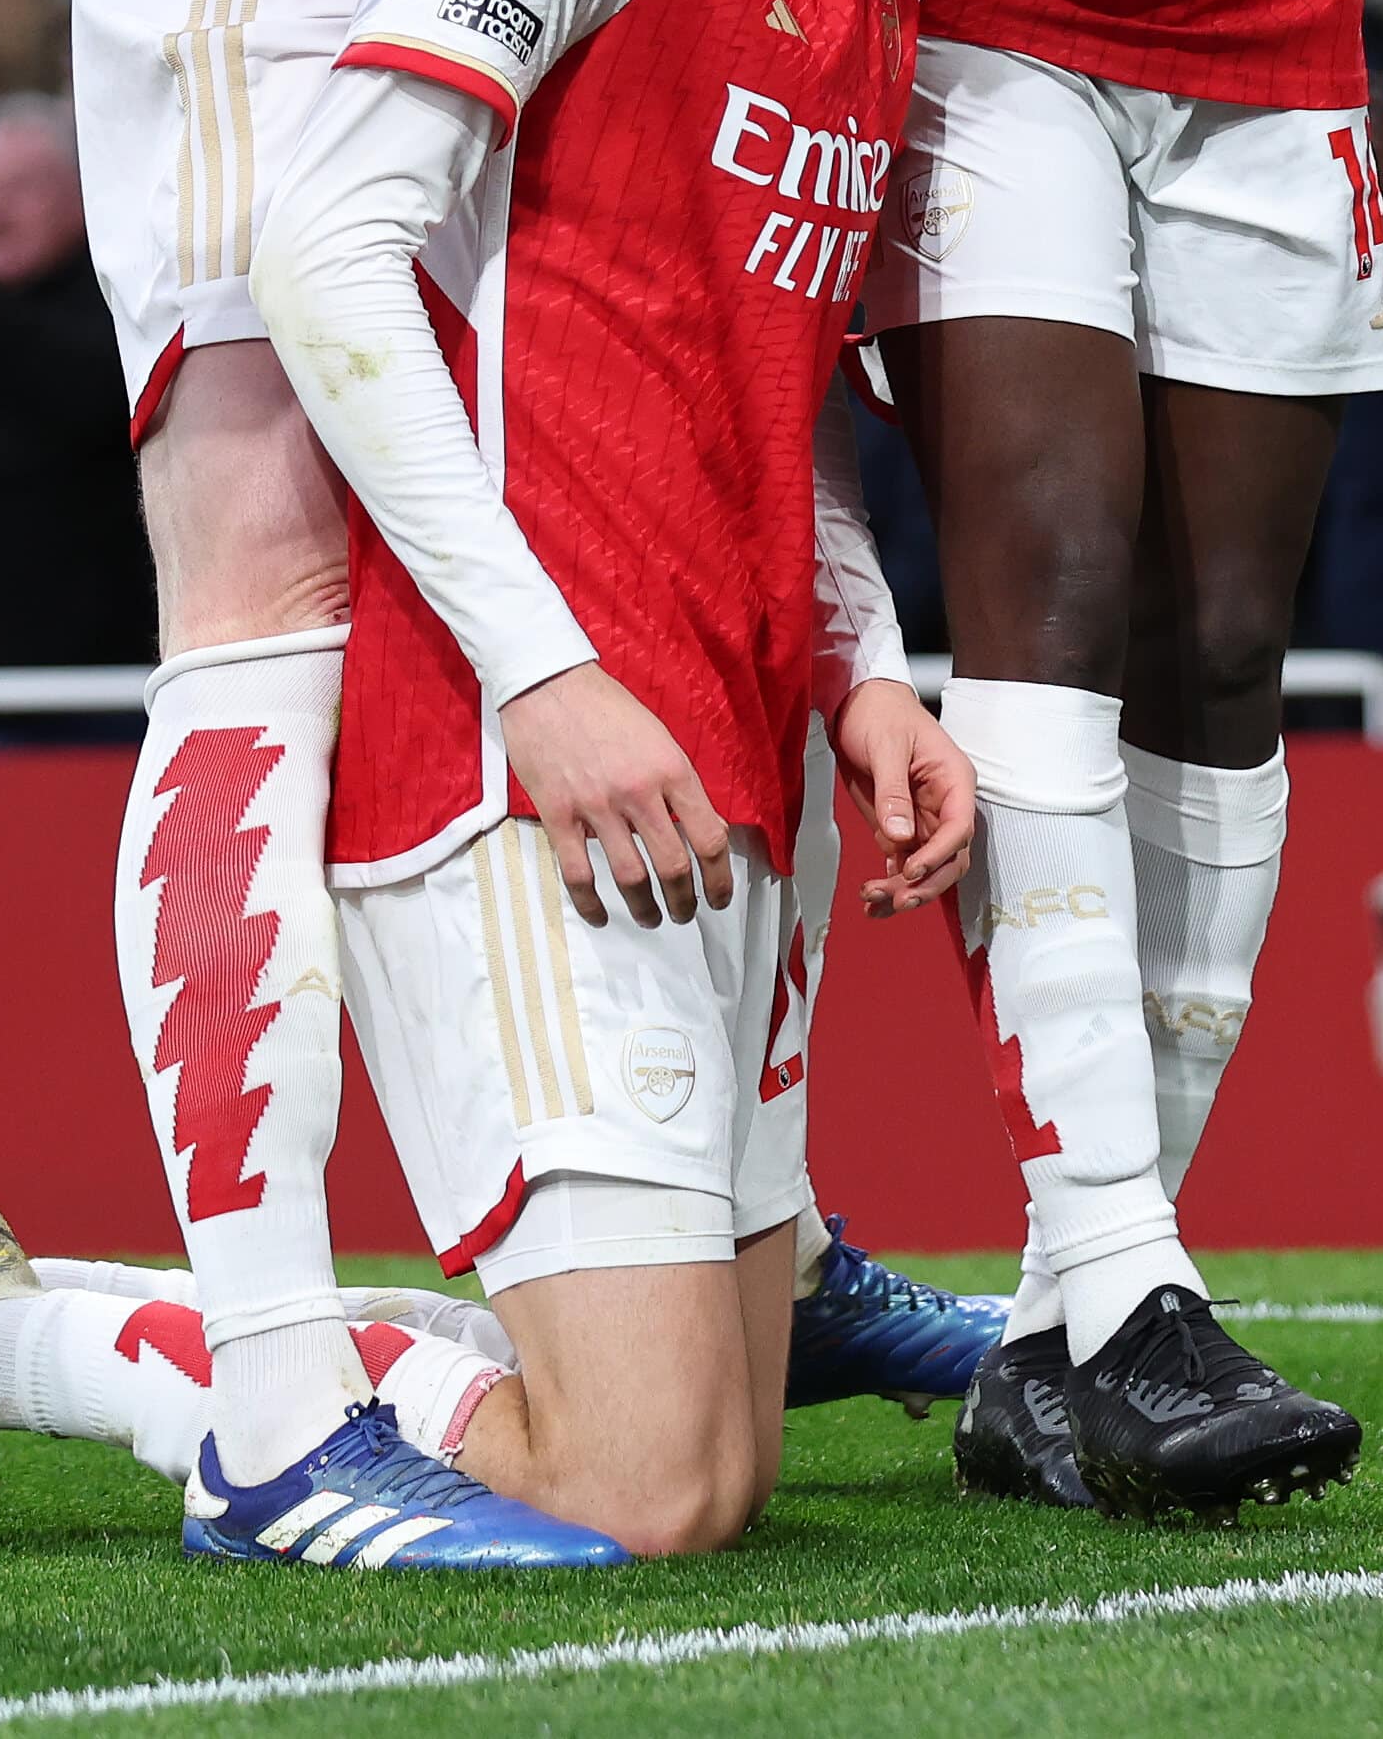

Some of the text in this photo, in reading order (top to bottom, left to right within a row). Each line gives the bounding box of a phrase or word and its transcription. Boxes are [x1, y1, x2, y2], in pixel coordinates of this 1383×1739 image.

[477, 12, 532, 65] racism
[743, 210, 842, 300] FLY
[633, 1041, 687, 1062] Arsenal
